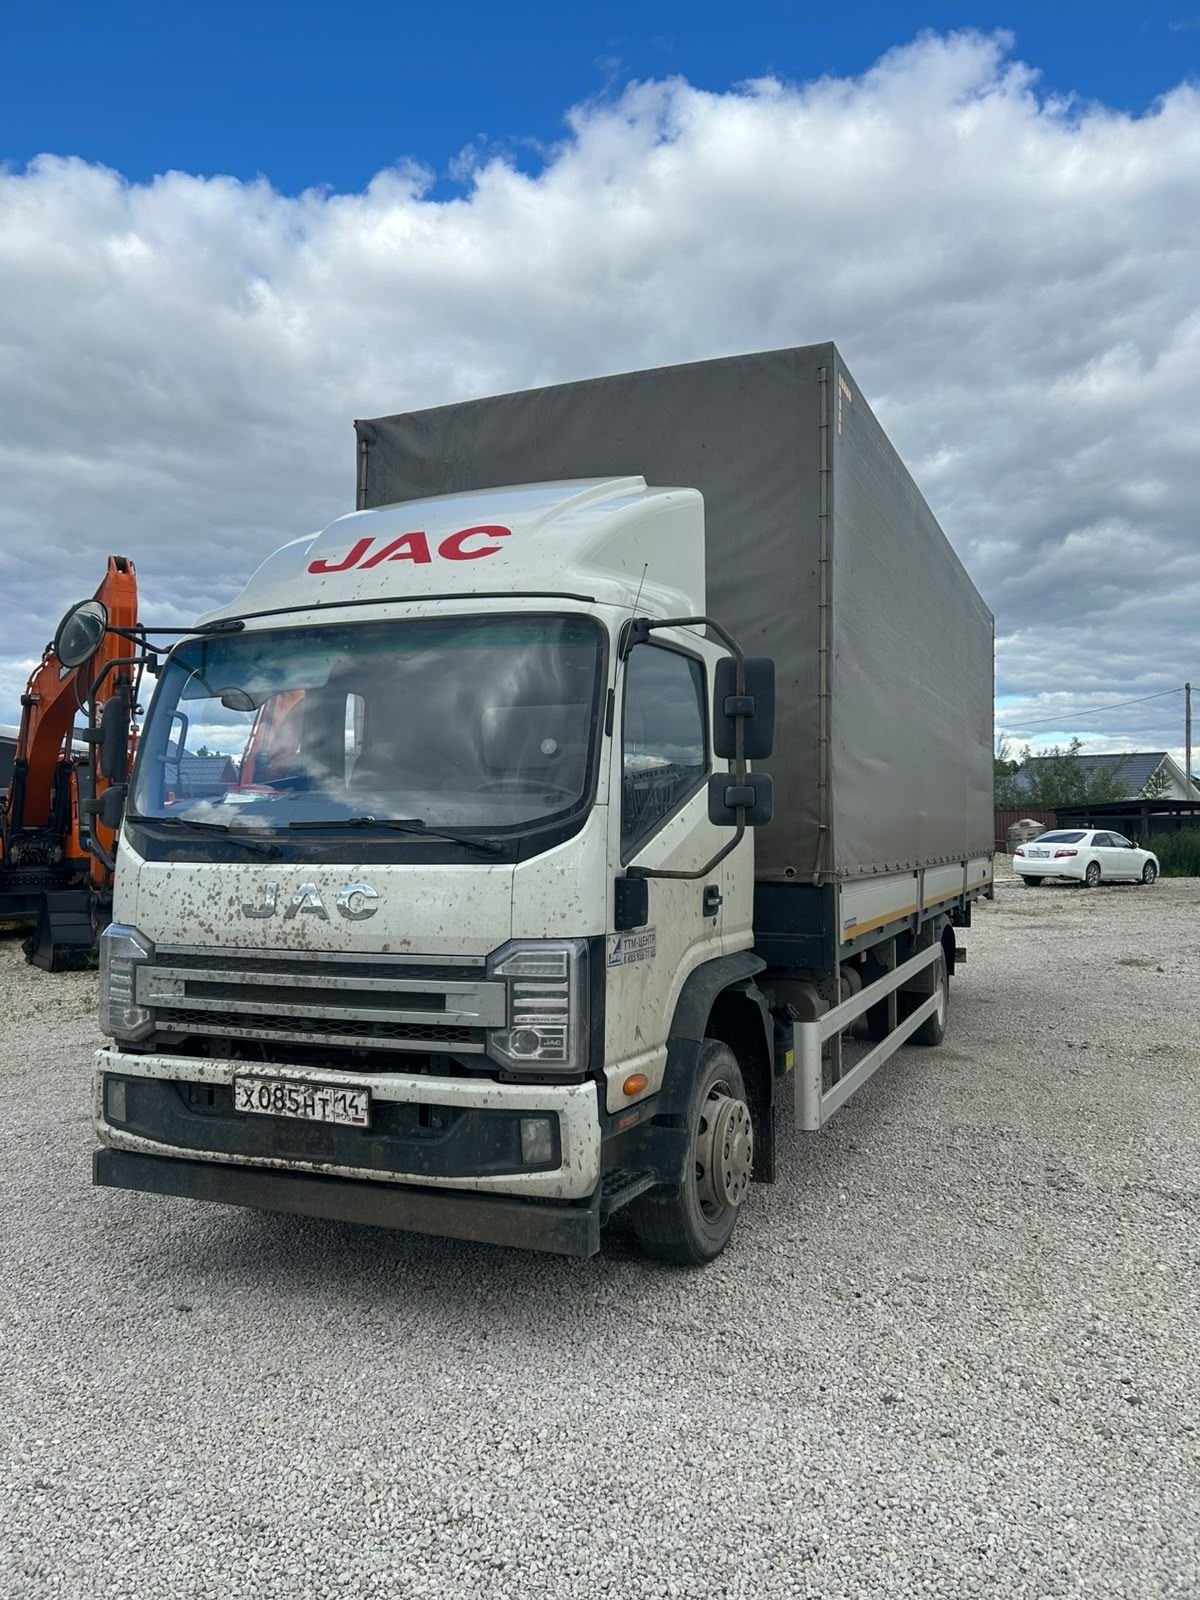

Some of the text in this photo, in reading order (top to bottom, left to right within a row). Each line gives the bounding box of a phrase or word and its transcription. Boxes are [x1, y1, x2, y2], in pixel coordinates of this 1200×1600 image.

[307, 525, 512, 574] JAC
[241, 882, 379, 921] JAC
[242, 1085, 359, 1121] Х085НТ 14
